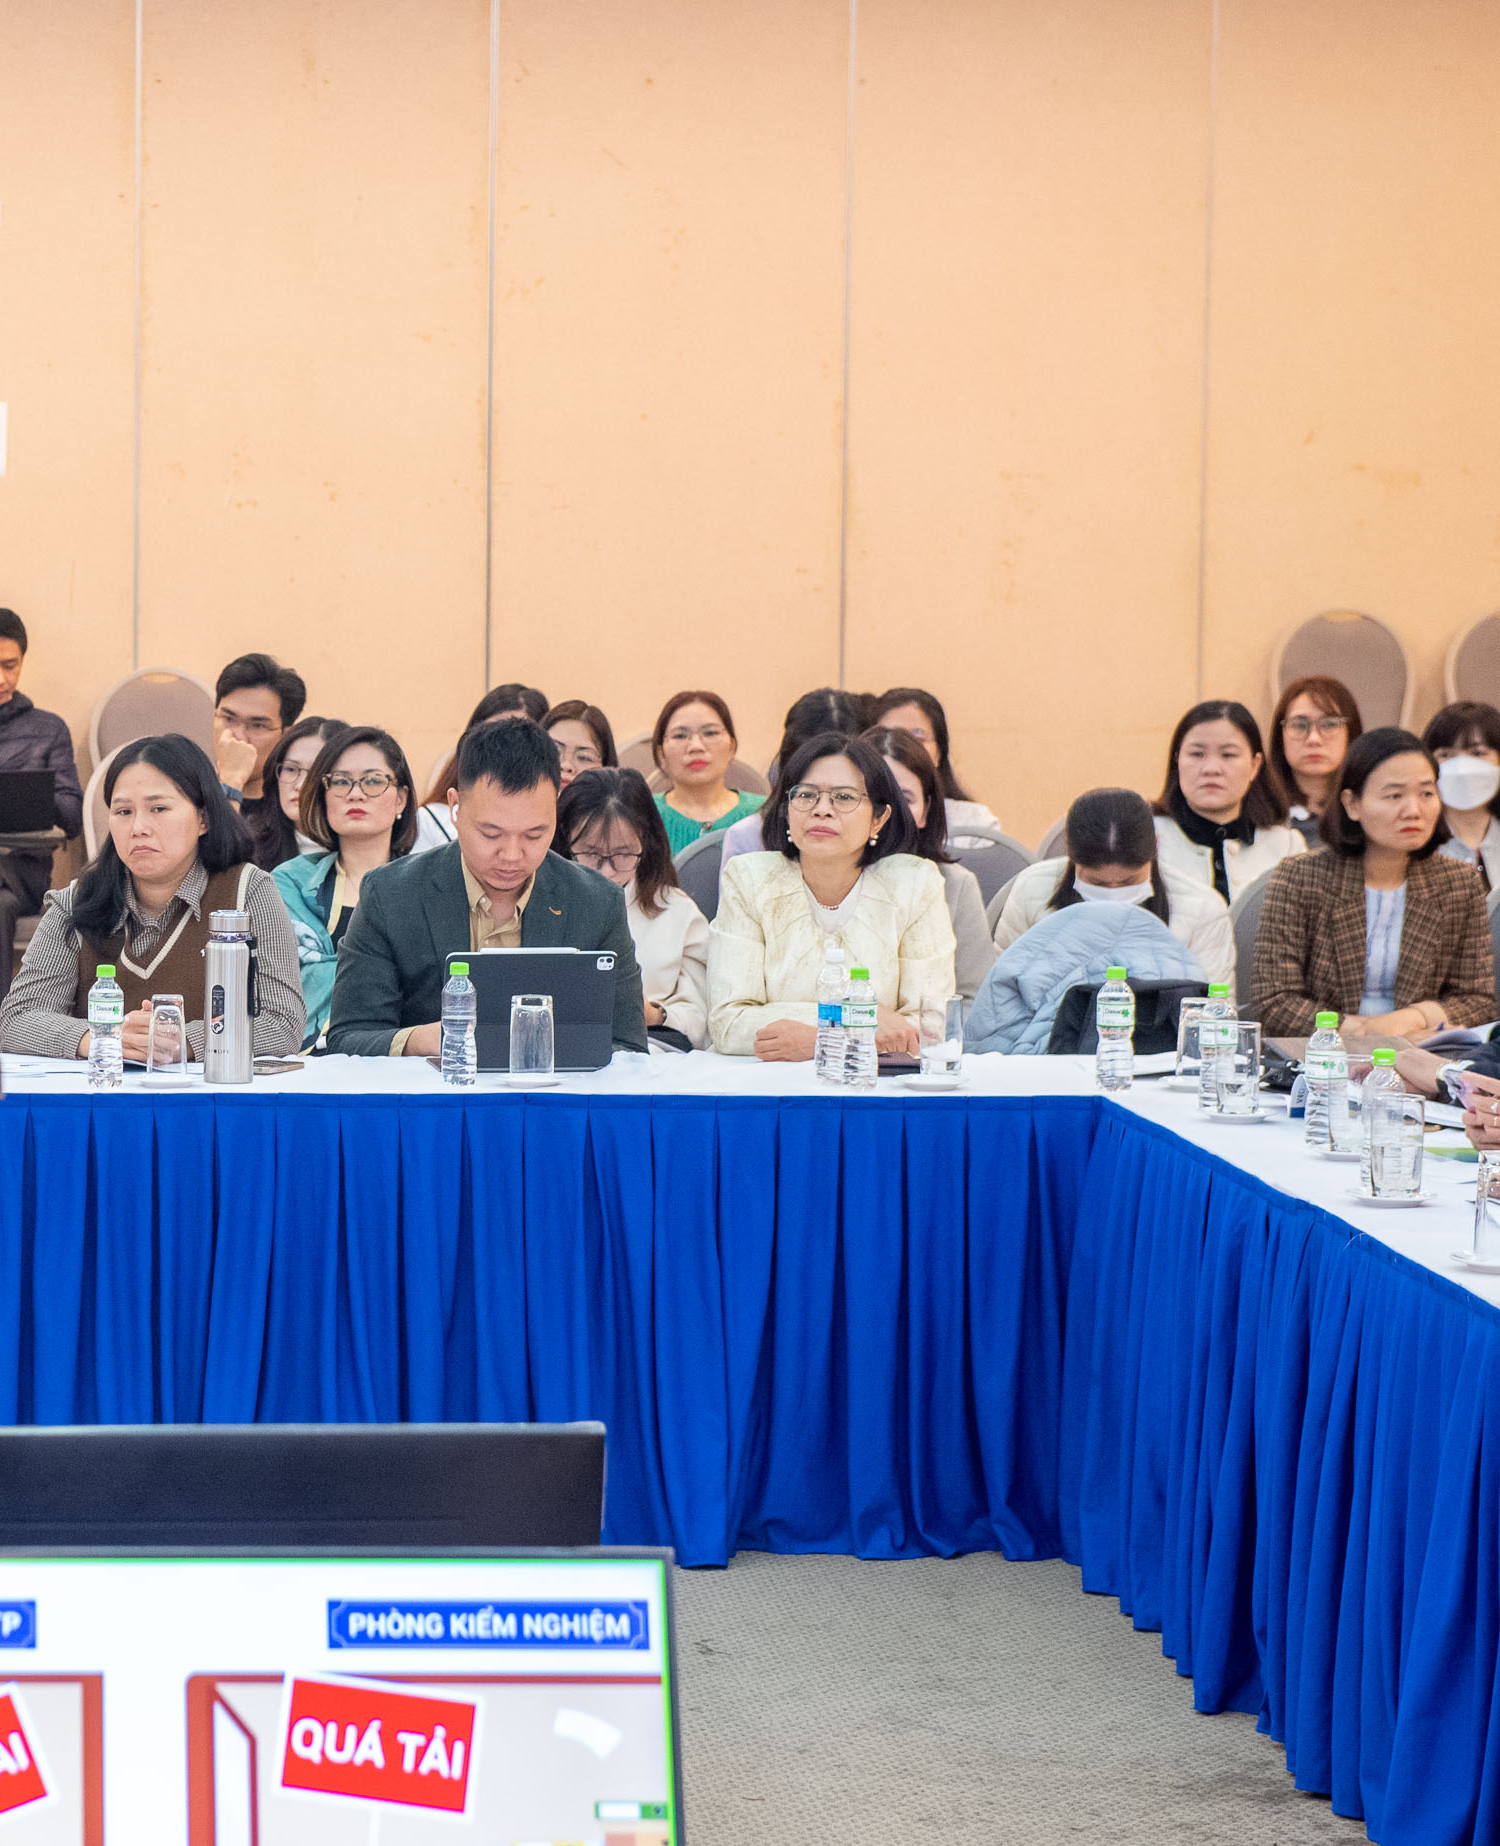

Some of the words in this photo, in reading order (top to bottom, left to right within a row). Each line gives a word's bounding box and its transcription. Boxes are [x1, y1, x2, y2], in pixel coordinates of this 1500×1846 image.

[348, 1607, 445, 1640] PHÒNG
[450, 1605, 517, 1640] KIỂM
[523, 1607, 631, 1643] NGHIỆM
[291, 1716, 385, 1770] QUÁ
[397, 1724, 465, 1780] TẢI
